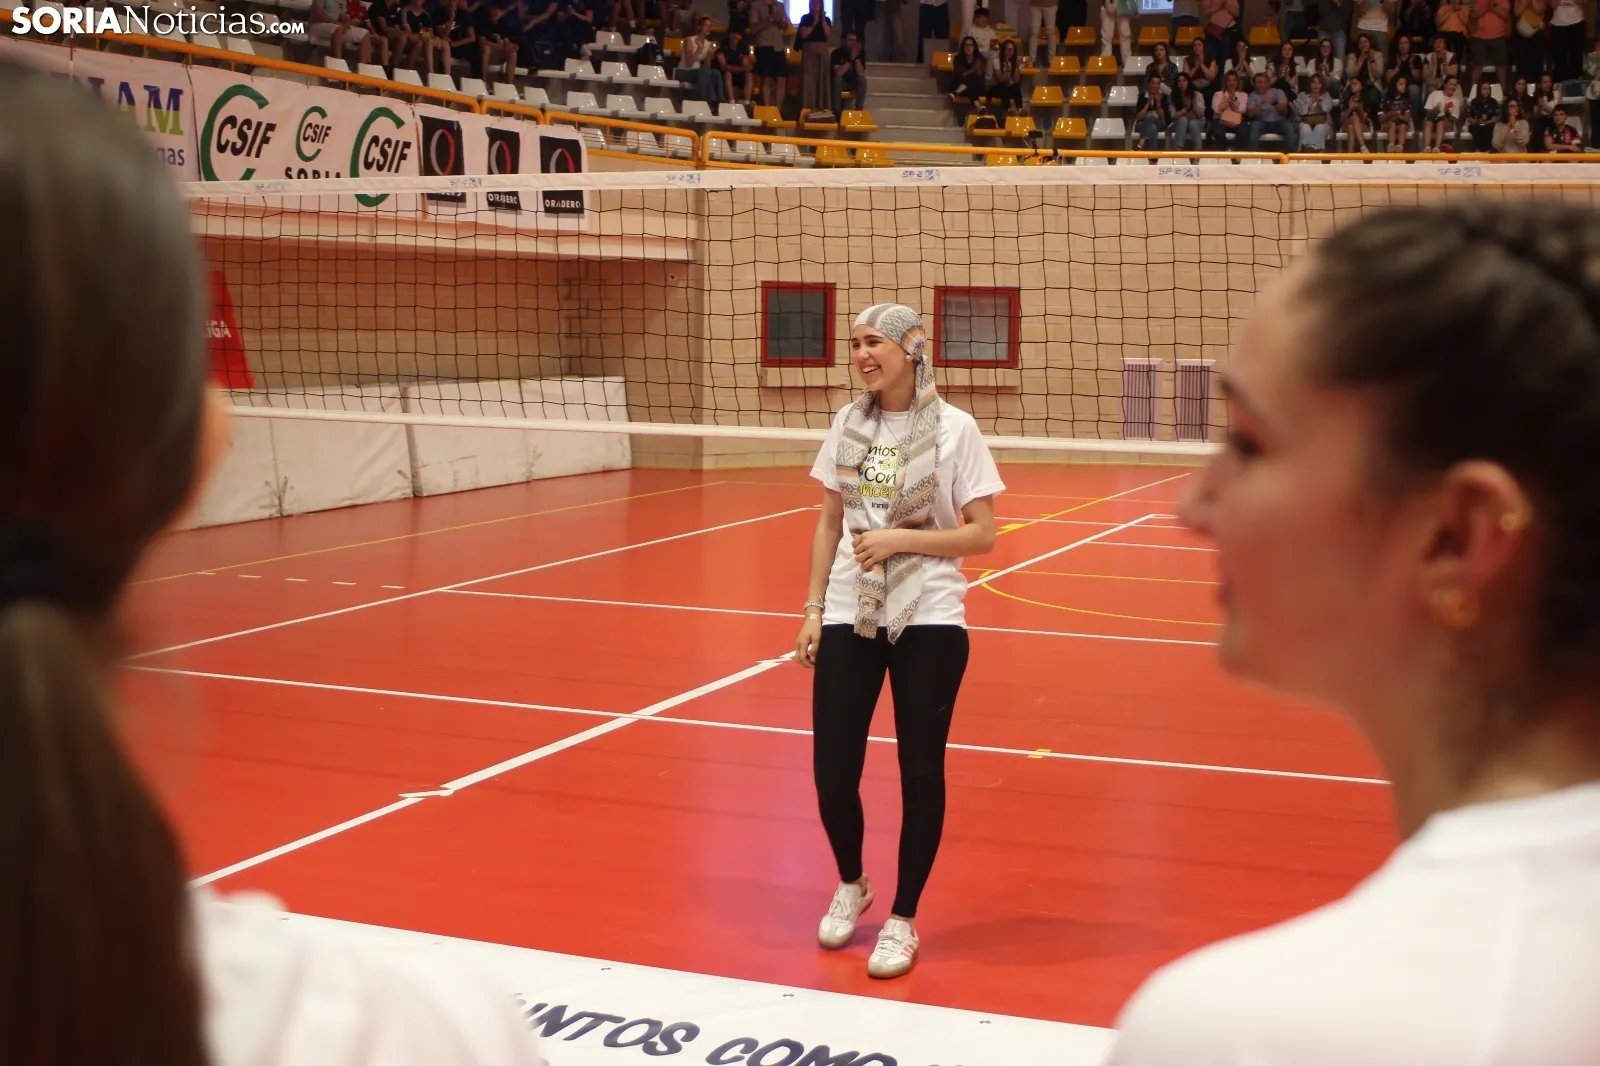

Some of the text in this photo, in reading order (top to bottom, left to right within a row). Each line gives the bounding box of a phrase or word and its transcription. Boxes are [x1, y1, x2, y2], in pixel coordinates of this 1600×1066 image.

[216, 115, 277, 158] CSIF
[302, 122, 332, 144] CSIF
[363, 134, 412, 174] CSIF
[544, 199, 582, 209] ORADERO
[867, 445, 897, 457] ntos
[861, 483, 895, 500] ncer
